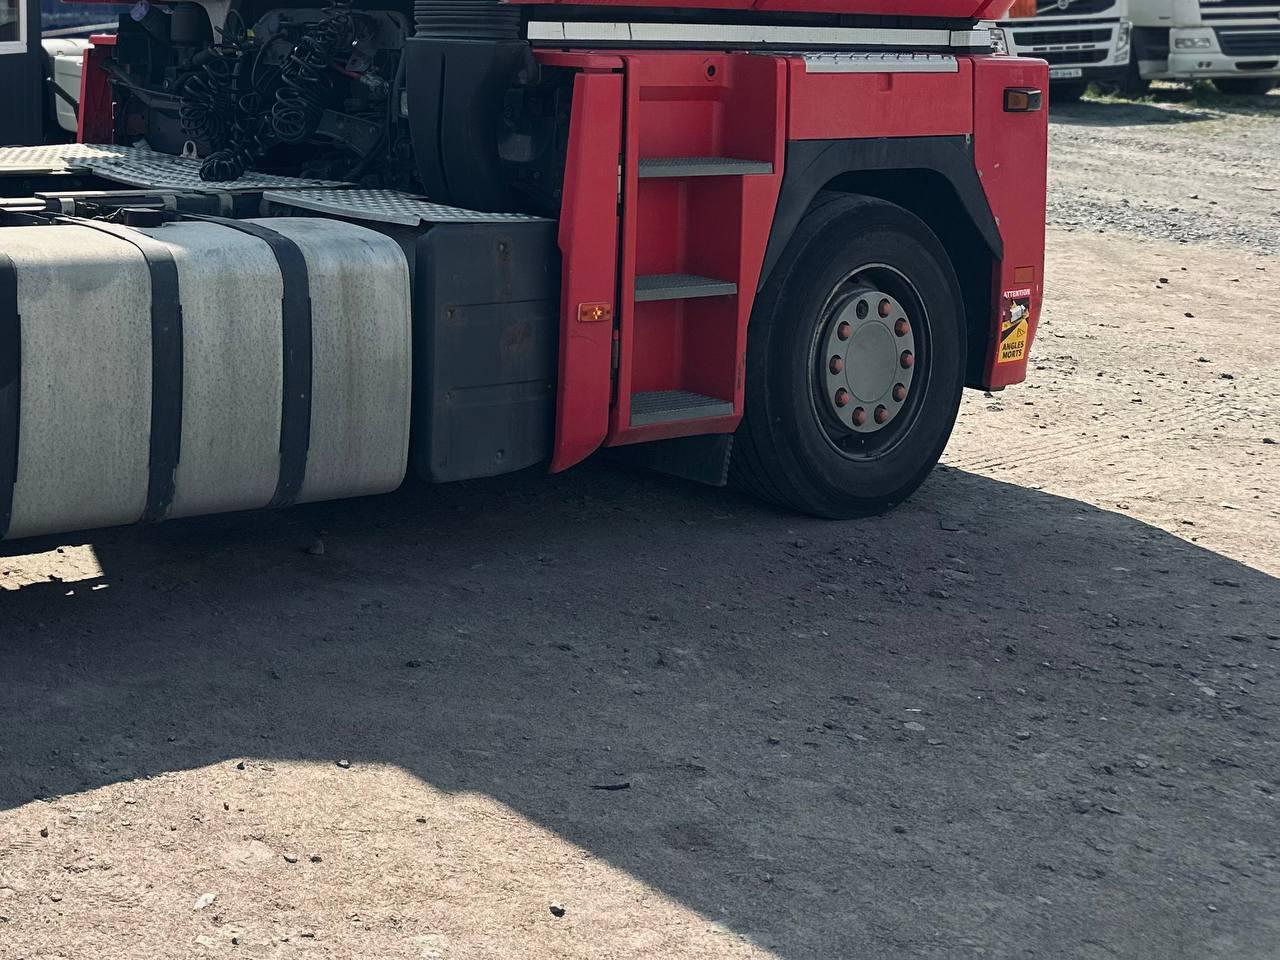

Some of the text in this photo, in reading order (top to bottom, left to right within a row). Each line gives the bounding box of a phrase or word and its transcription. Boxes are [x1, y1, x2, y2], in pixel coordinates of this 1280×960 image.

[1004, 288, 1031, 298] ATTENTION
[1002, 341, 1024, 351] ANGLES
[1002, 349, 1022, 359] MORTS
